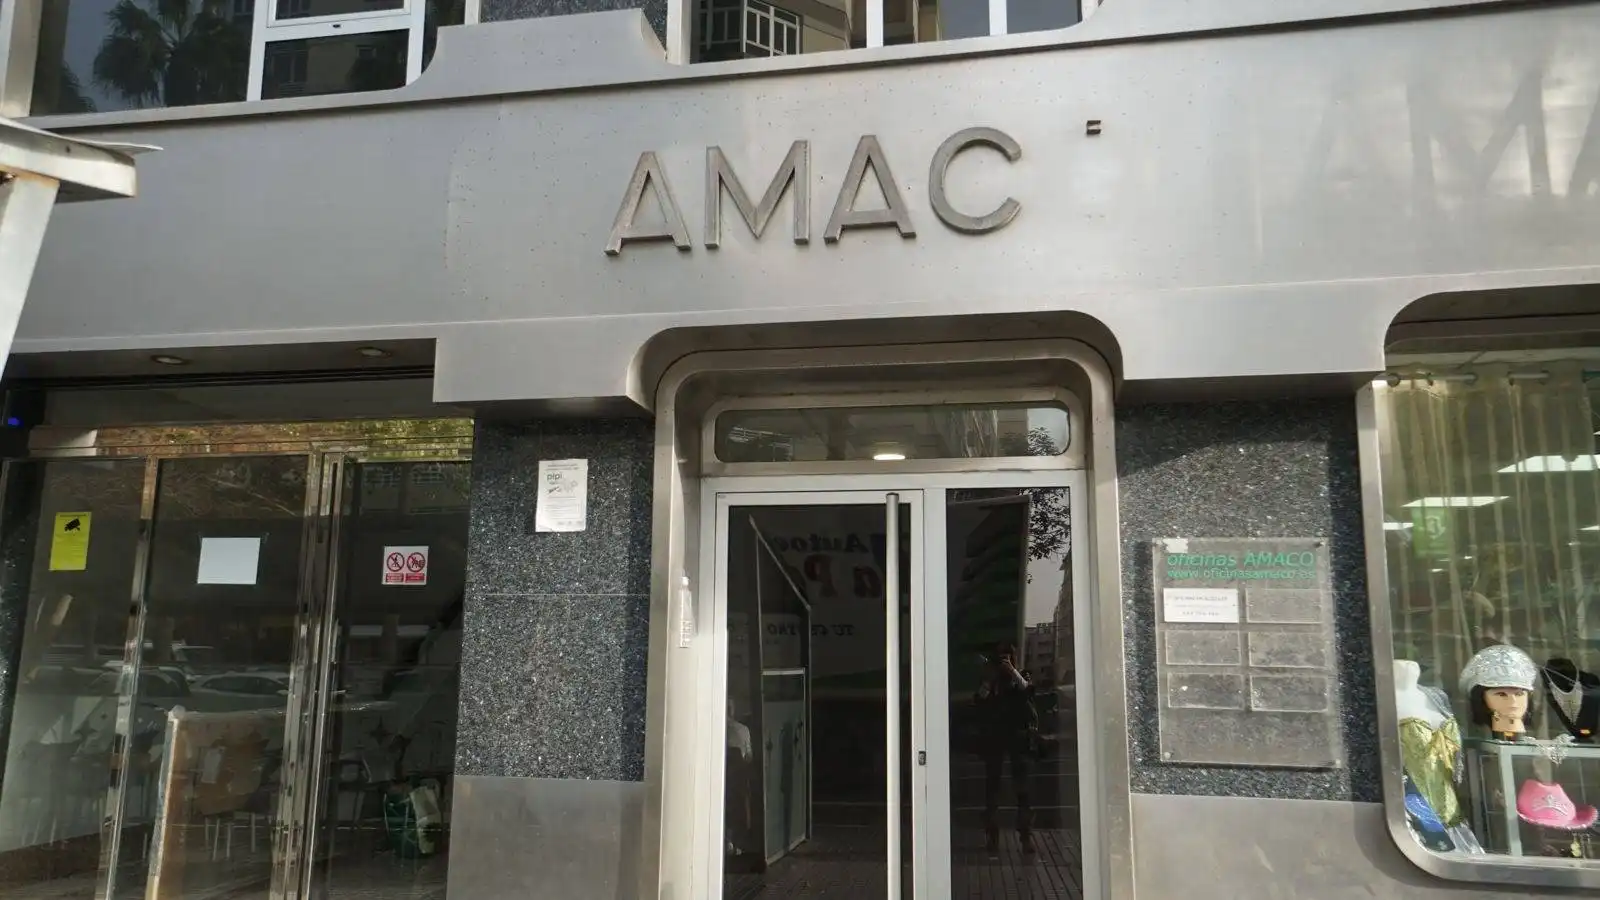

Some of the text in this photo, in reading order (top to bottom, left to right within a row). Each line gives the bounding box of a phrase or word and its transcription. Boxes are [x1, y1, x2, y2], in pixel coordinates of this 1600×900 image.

[604, 126, 1022, 256] AMAC
[1166, 550, 1315, 567] oficinas AMACO
